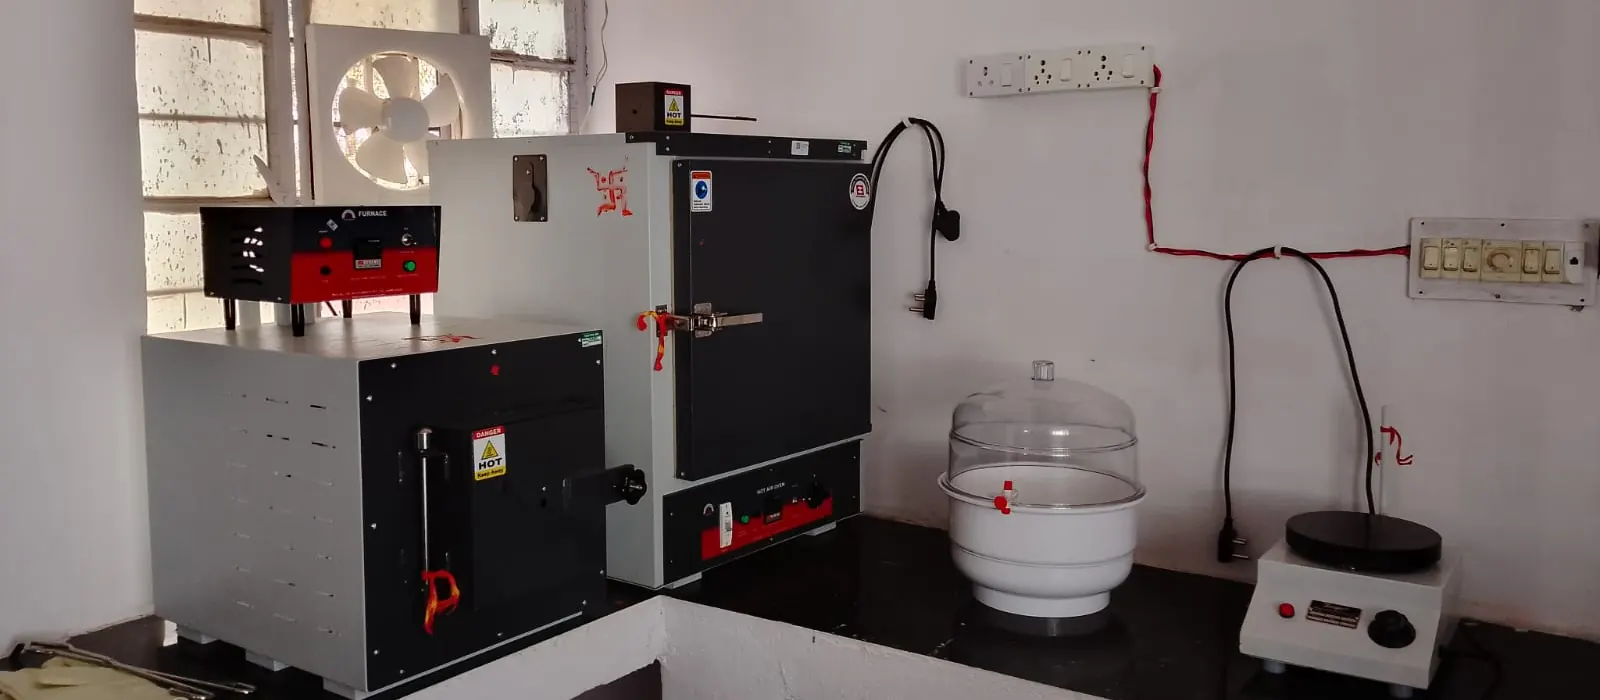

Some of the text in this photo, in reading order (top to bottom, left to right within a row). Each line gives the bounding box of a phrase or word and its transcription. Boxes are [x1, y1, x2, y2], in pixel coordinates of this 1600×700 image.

[476, 428, 501, 438] DANGER
[479, 457, 502, 470] HOT
[477, 471, 490, 479] Keep
[774, 482, 785, 490] OVEN
